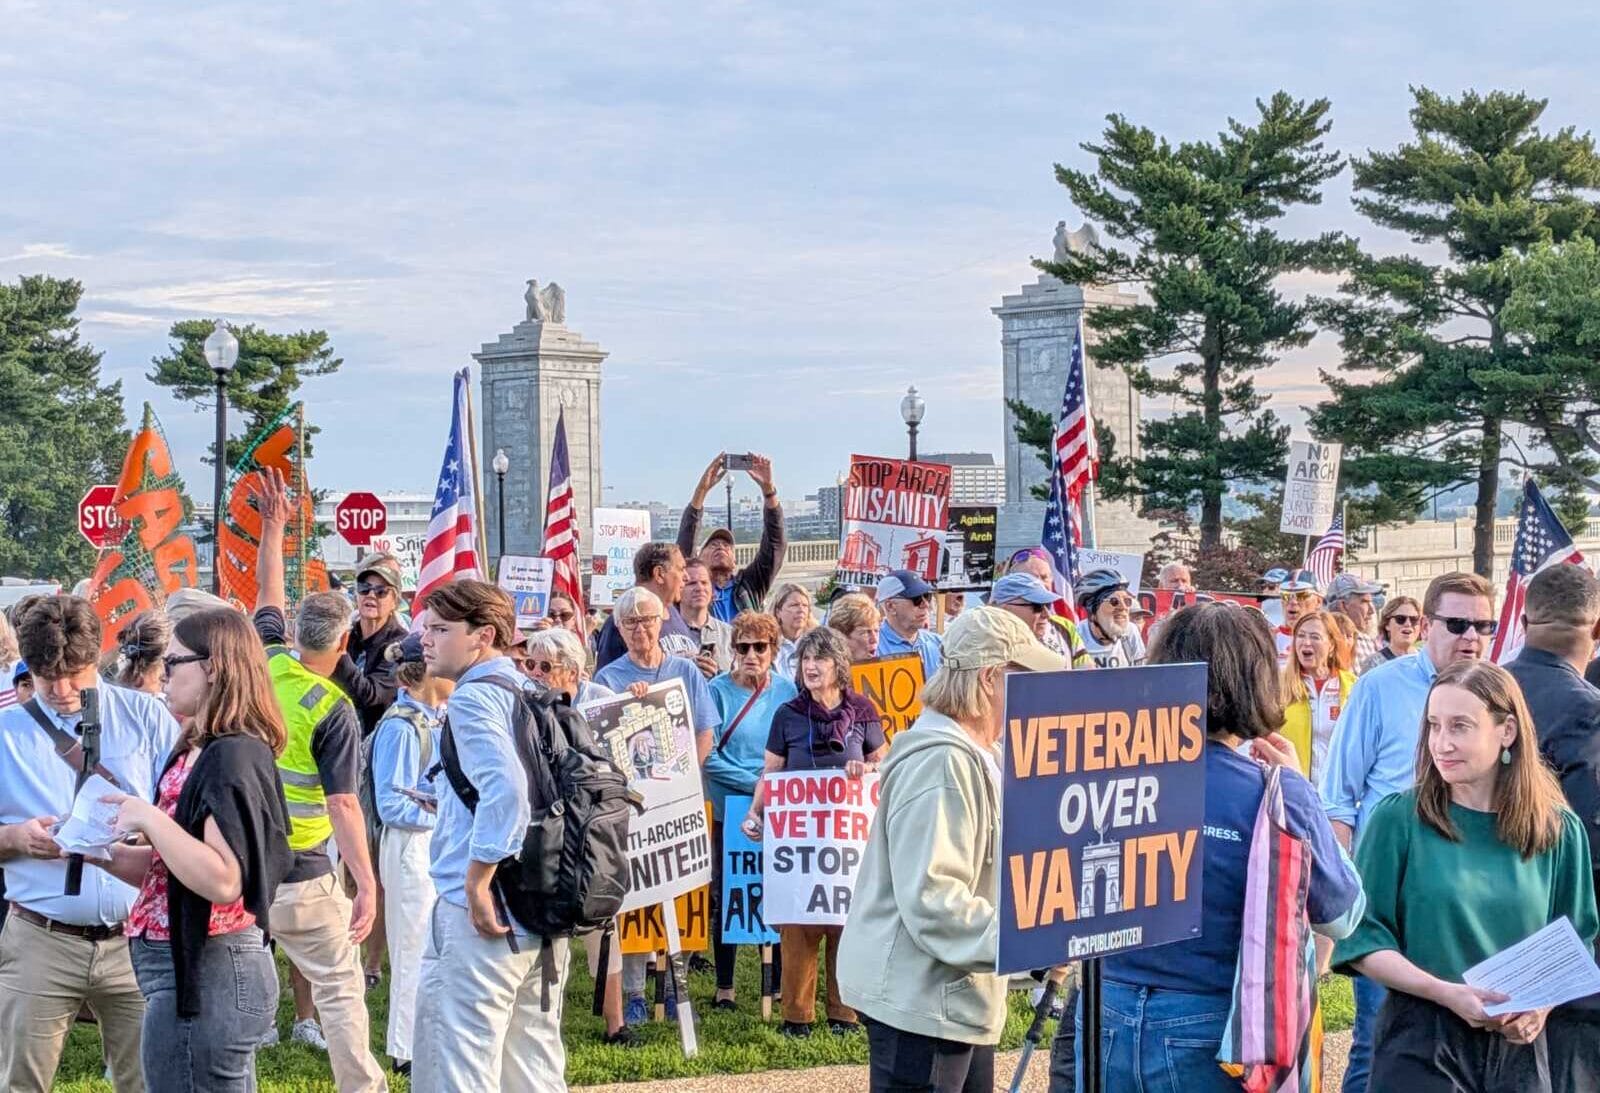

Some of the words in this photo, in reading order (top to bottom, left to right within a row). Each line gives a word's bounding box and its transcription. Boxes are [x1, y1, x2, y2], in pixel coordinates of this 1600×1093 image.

[1308, 443, 1330, 460] NO
[851, 462, 892, 489] STOP
[896, 465, 949, 498] ARCH
[1295, 461, 1336, 480] ARCH
[83, 505, 122, 529] STO
[338, 508, 384, 530] STOP
[847, 486, 947, 529] INSANITY
[960, 514, 995, 527] Against
[970, 531, 993, 542] Arch
[861, 668, 916, 713] NO
[1010, 704, 1203, 779] VETERANS
[764, 776, 864, 807] HONOR
[1059, 776, 1160, 836] OVER
[627, 811, 705, 851] TI-ARCHERS
[626, 833, 709, 893] NITE!!!
[773, 846, 860, 876] STOP
